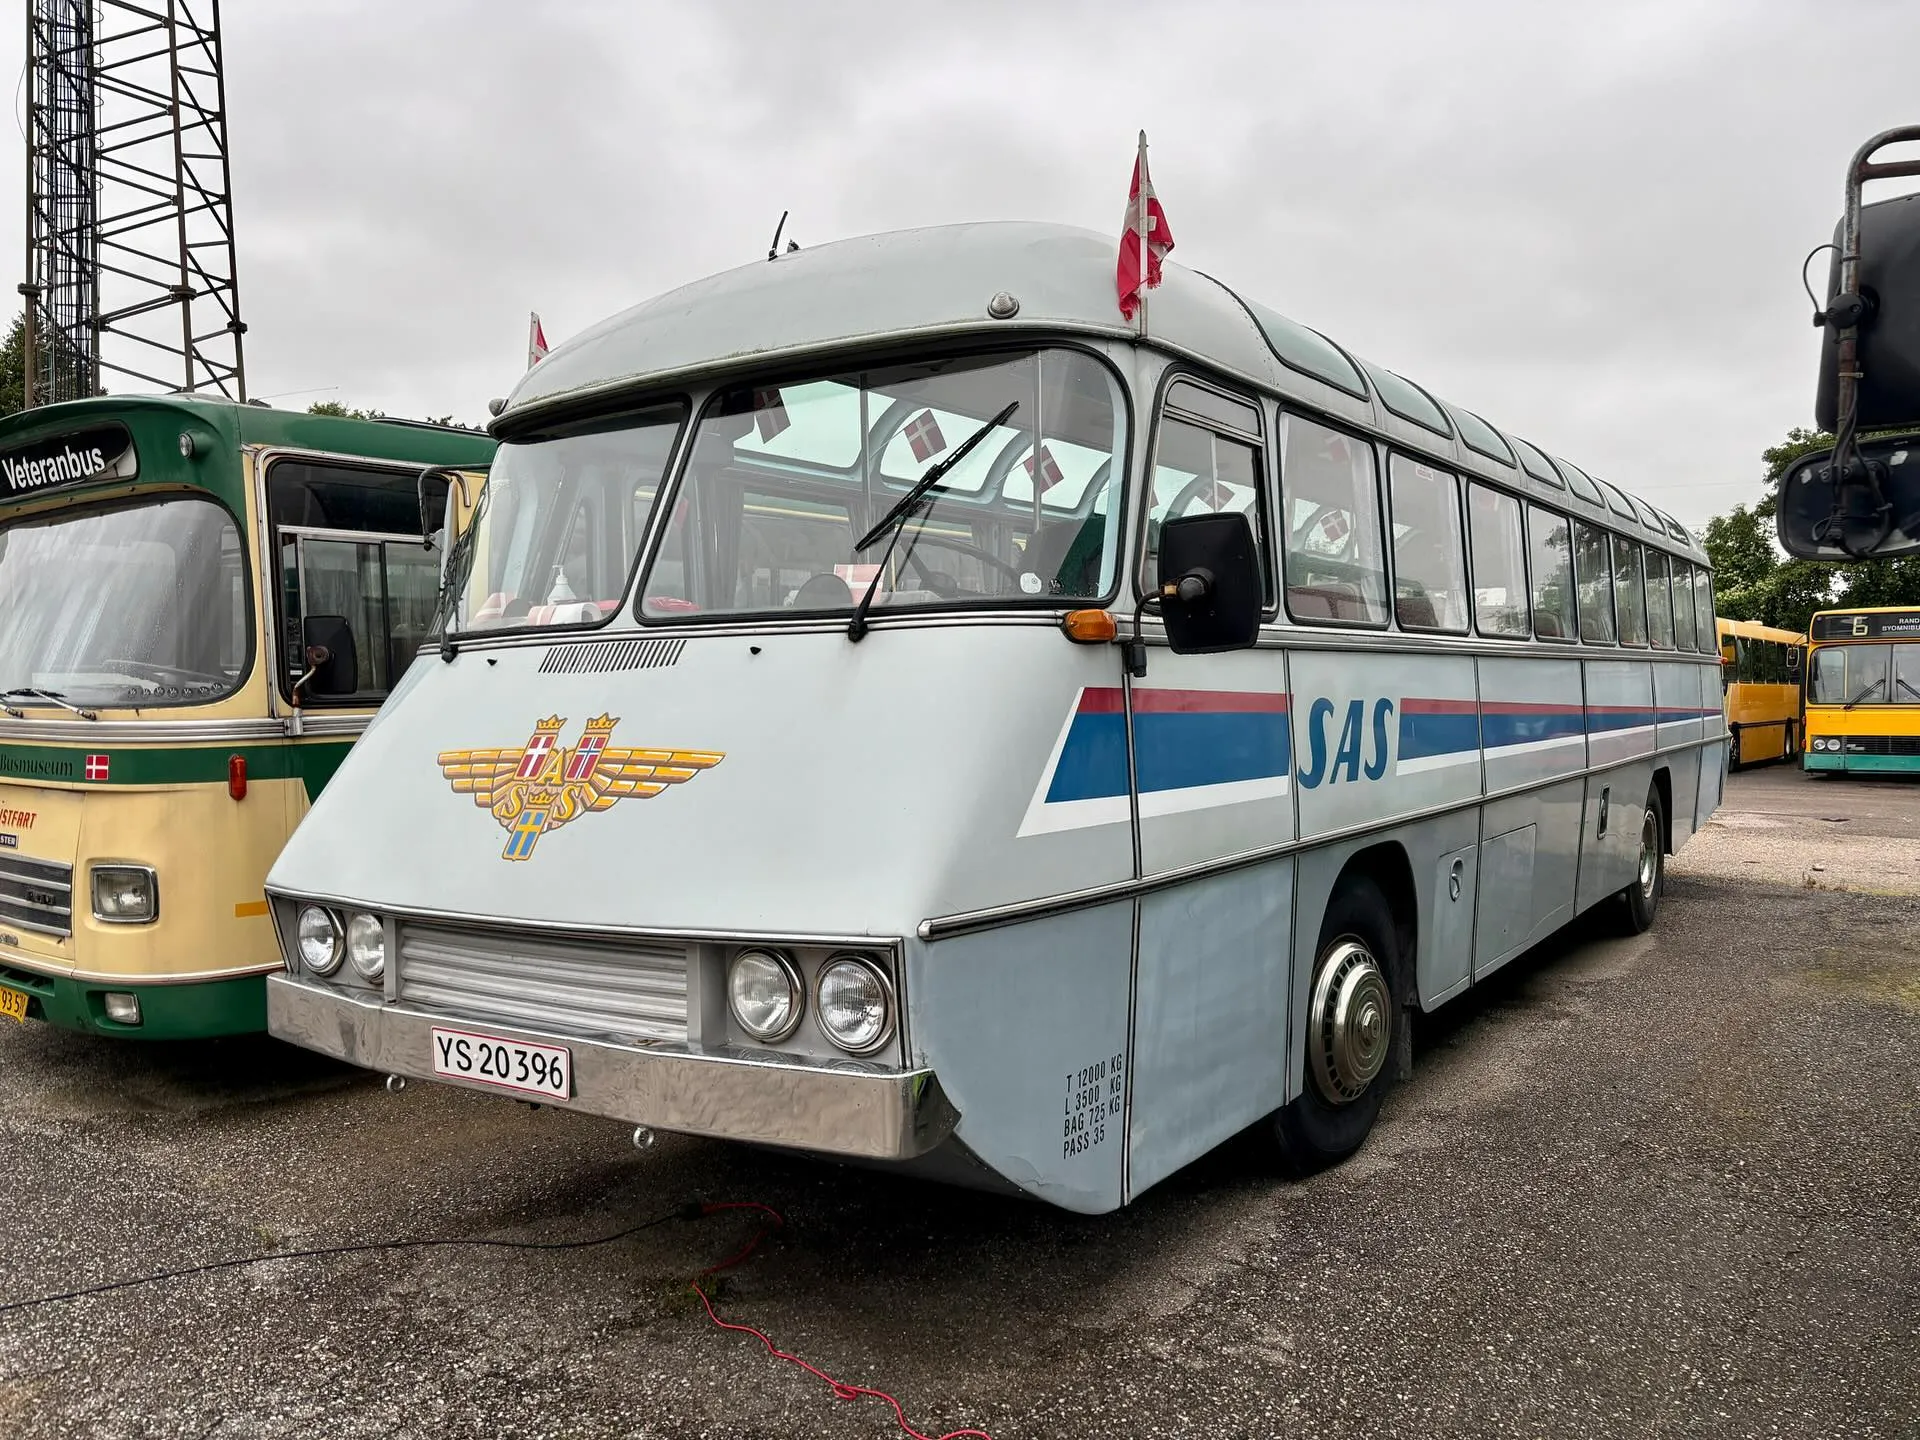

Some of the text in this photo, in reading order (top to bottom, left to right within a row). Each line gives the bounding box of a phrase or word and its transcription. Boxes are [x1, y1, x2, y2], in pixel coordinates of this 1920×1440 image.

[2, 445, 106, 490] Veteranbus
[1852, 616, 1869, 636] 6
[1298, 697, 1394, 790] SAS
[0, 753, 73, 777] Busmuseum
[437, 1035, 473, 1072] YS
[1066, 1053, 1122, 1093] T 12000 KG
[1065, 1074, 1121, 1116] L 3500 KG
[1064, 1095, 1120, 1137] BAG 725 KG
[1063, 1123, 1105, 1160] PASS 35
